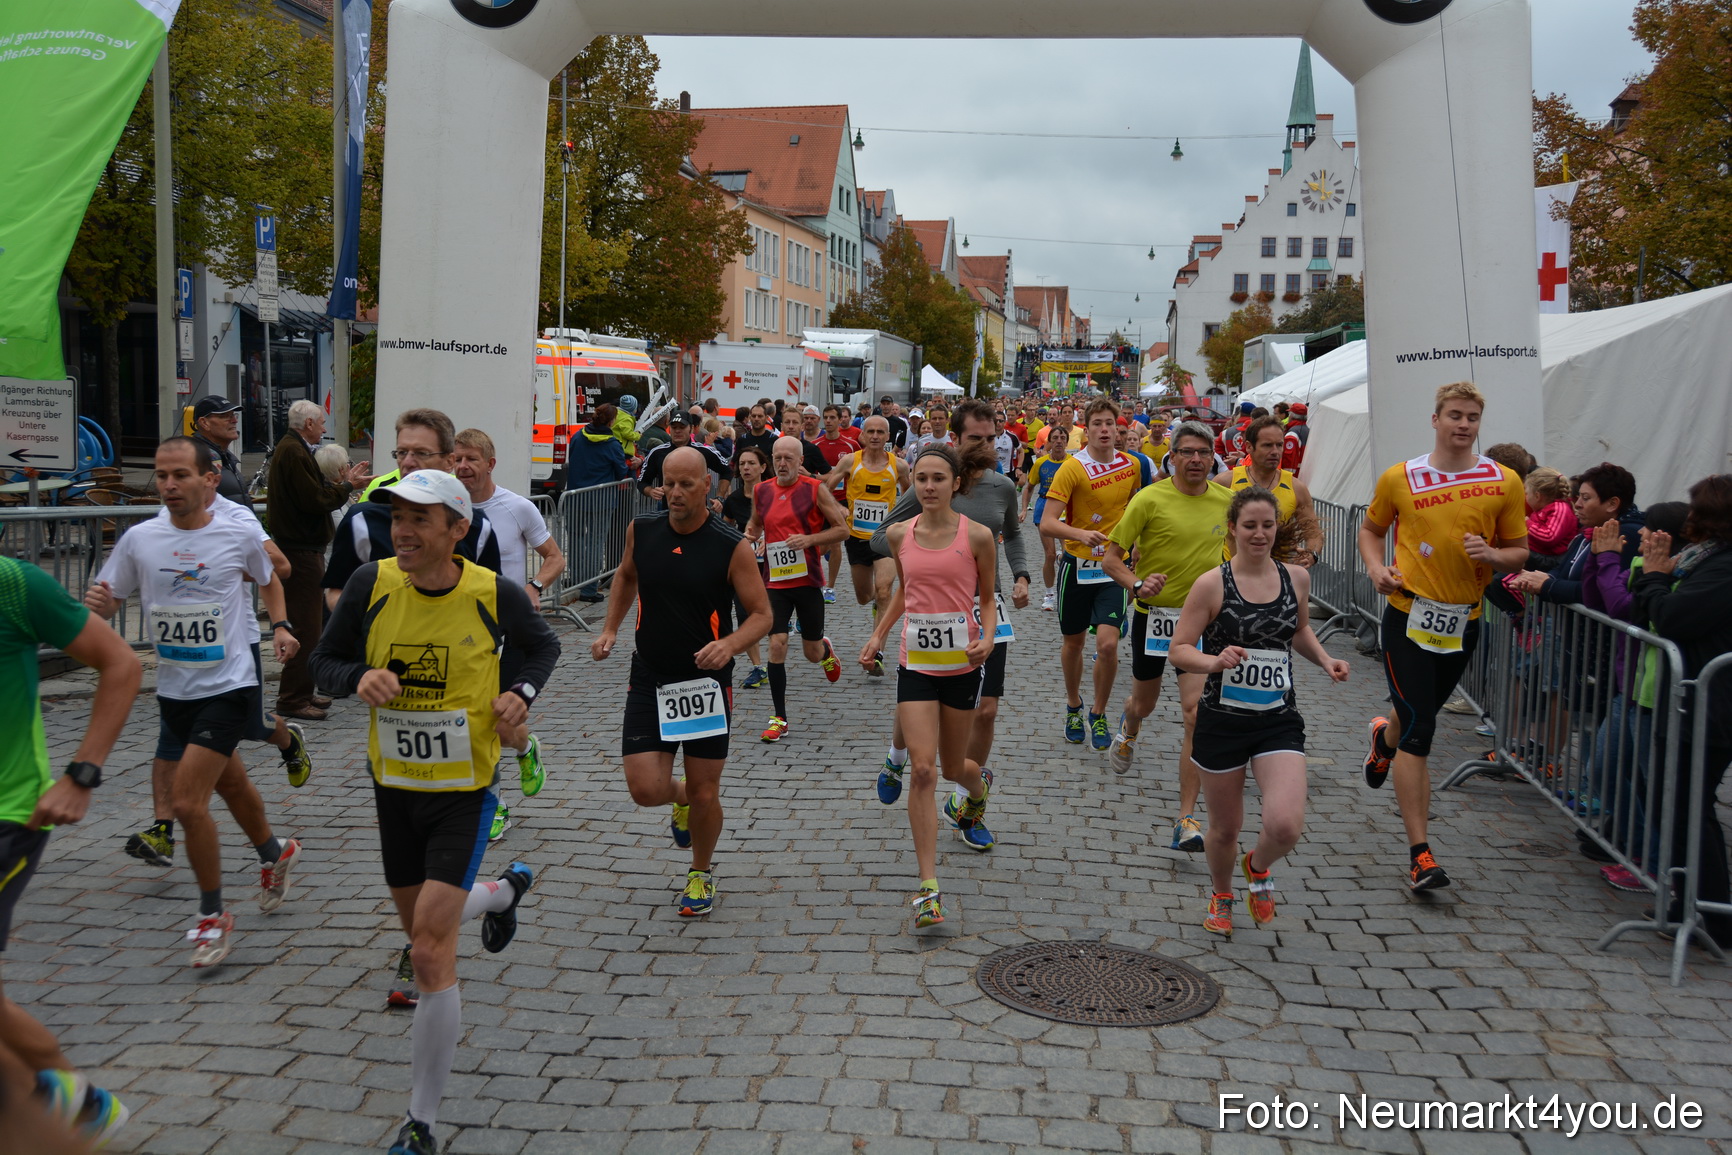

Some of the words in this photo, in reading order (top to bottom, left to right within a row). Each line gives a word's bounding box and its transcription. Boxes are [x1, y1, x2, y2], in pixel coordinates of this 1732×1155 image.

[379, 337, 508, 356] www.bmw-laufsport.de
[1395, 344, 1538, 364] www.bmw-laufsport.de
[744, 370, 778, 379] Bayerisches
[0, 385, 34, 395] ßgänger
[37, 386, 73, 397] Richtung
[5, 397, 59, 407] Lammsbräu-
[2, 409, 41, 419] Kreuzung
[43, 410, 62, 419] über
[19, 422, 46, 430] Untere
[6, 432, 59, 443] Kaserngasse
[1090, 478, 1113, 491] MAX
[1115, 469, 1136, 482] BÖGL
[1413, 491, 1455, 511] MAX
[1459, 484, 1505, 500] BÖGL
[856, 507, 885, 522] 3011
[773, 549, 798, 566] 189
[779, 567, 793, 575] Peter
[151, 610, 172, 618] PARTL
[173, 610, 209, 618] Neumarkt
[909, 617, 925, 625] PARTL
[926, 617, 956, 625] Neumarkt
[1420, 610, 1459, 635] 358
[157, 619, 217, 644] 2446
[917, 626, 955, 649] 531
[1426, 635, 1442, 646] Jan
[171, 648, 207, 660] Michael
[1251, 655, 1281, 663] Neumarkt
[1230, 662, 1285, 689] 3096
[400, 687, 446, 700] IRSCH
[658, 688, 678, 697] PARTL
[679, 683, 710, 694] Neumarkt
[665, 691, 717, 720] 3097
[378, 715, 406, 726] PARTL
[408, 719, 452, 728] Neumarkt
[396, 729, 449, 760] 501
[400, 761, 437, 779] Josef
